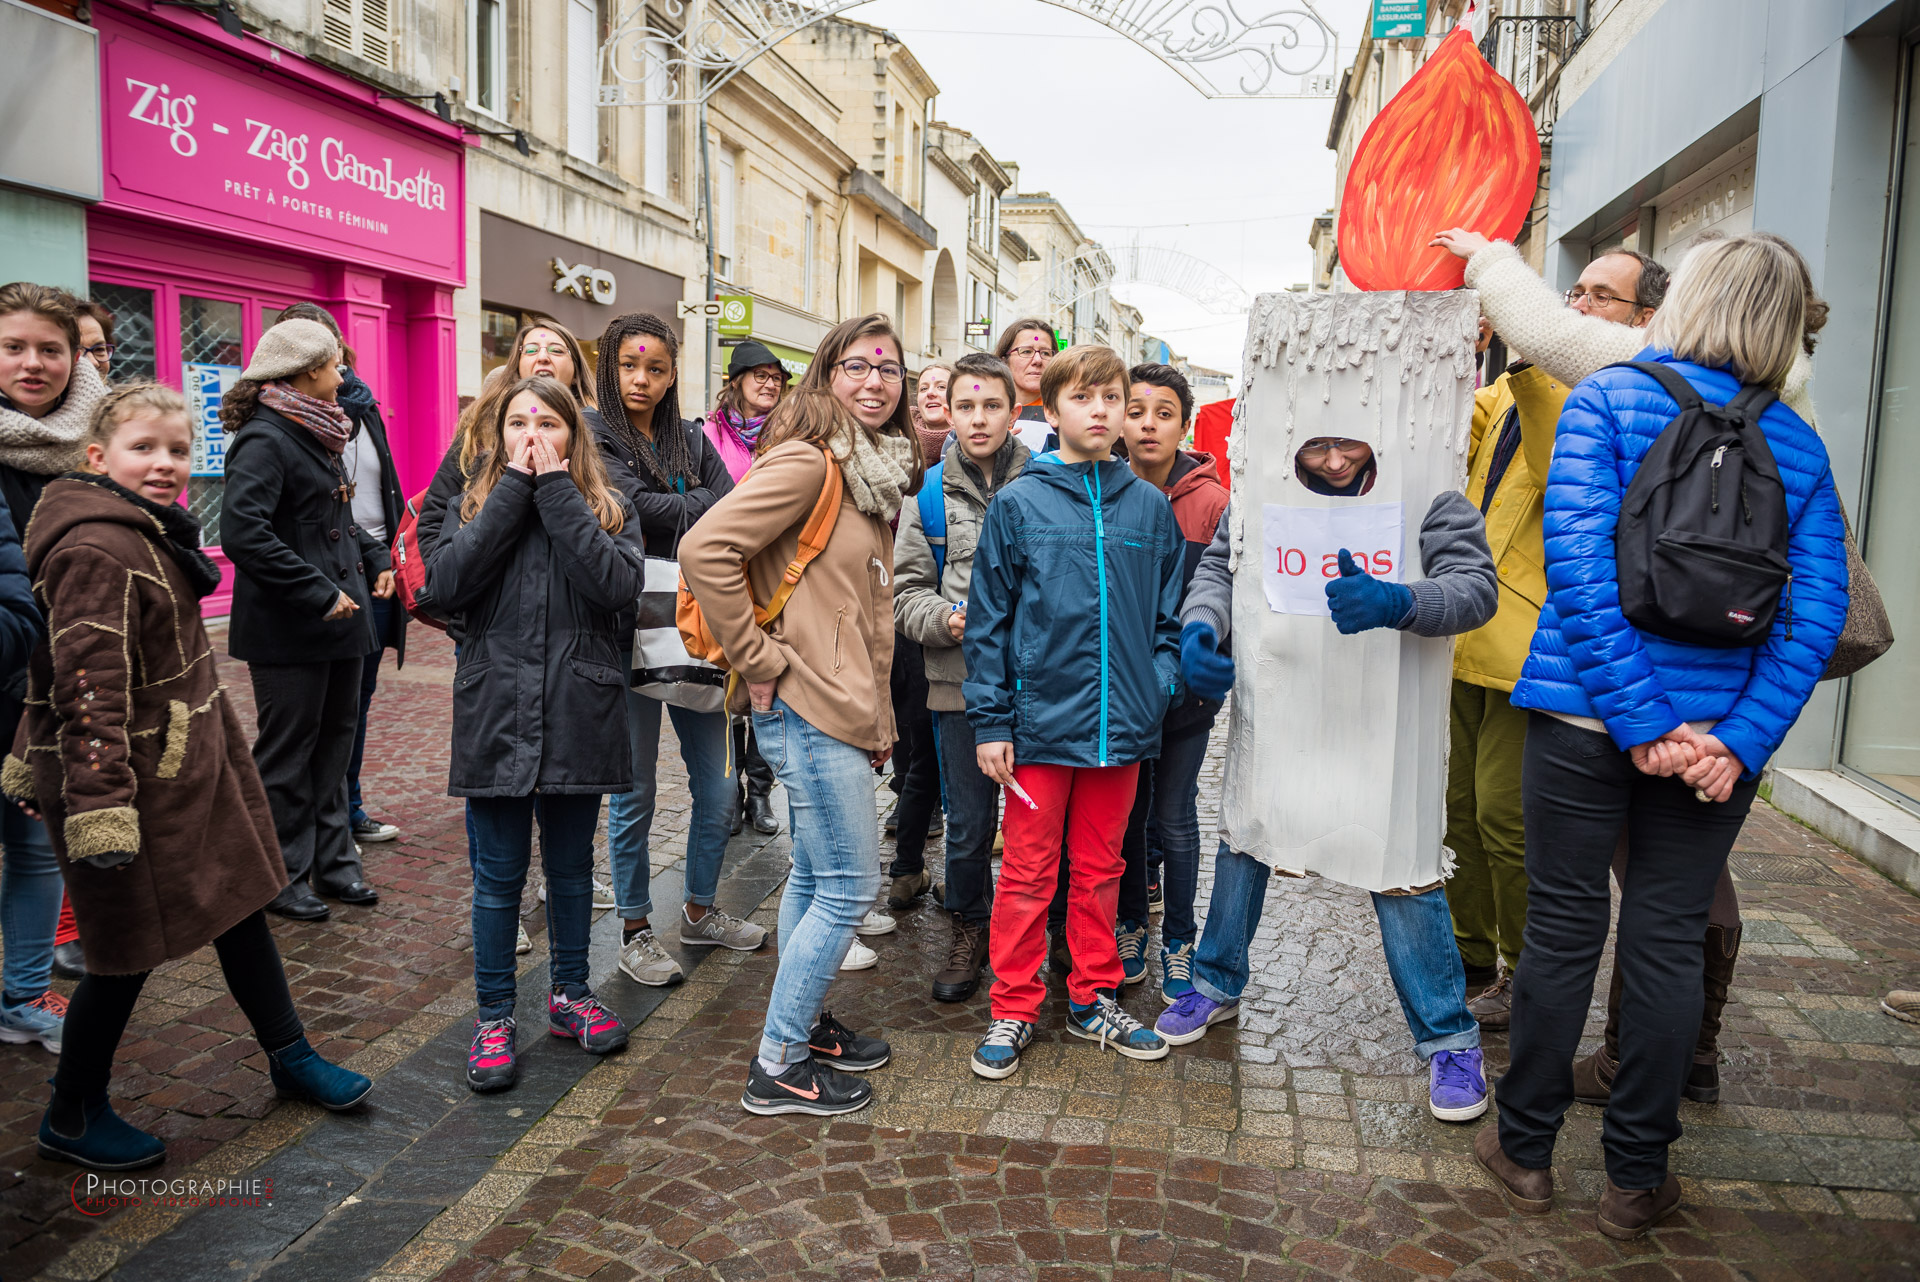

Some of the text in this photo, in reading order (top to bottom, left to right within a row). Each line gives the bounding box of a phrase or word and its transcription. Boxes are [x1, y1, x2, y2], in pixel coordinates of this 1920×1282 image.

[1376, 13, 1422, 21] ASSURANCES
[125, 77, 198, 157] Zig
[245, 118, 309, 190] Zag
[320, 137, 446, 211] Gambetta
[224, 179, 389, 234] PRÊT À PORTER FÉMININ
[553, 256, 617, 305] XO
[201, 370, 225, 470] A LOUER
[1276, 546, 1306, 576] 10
